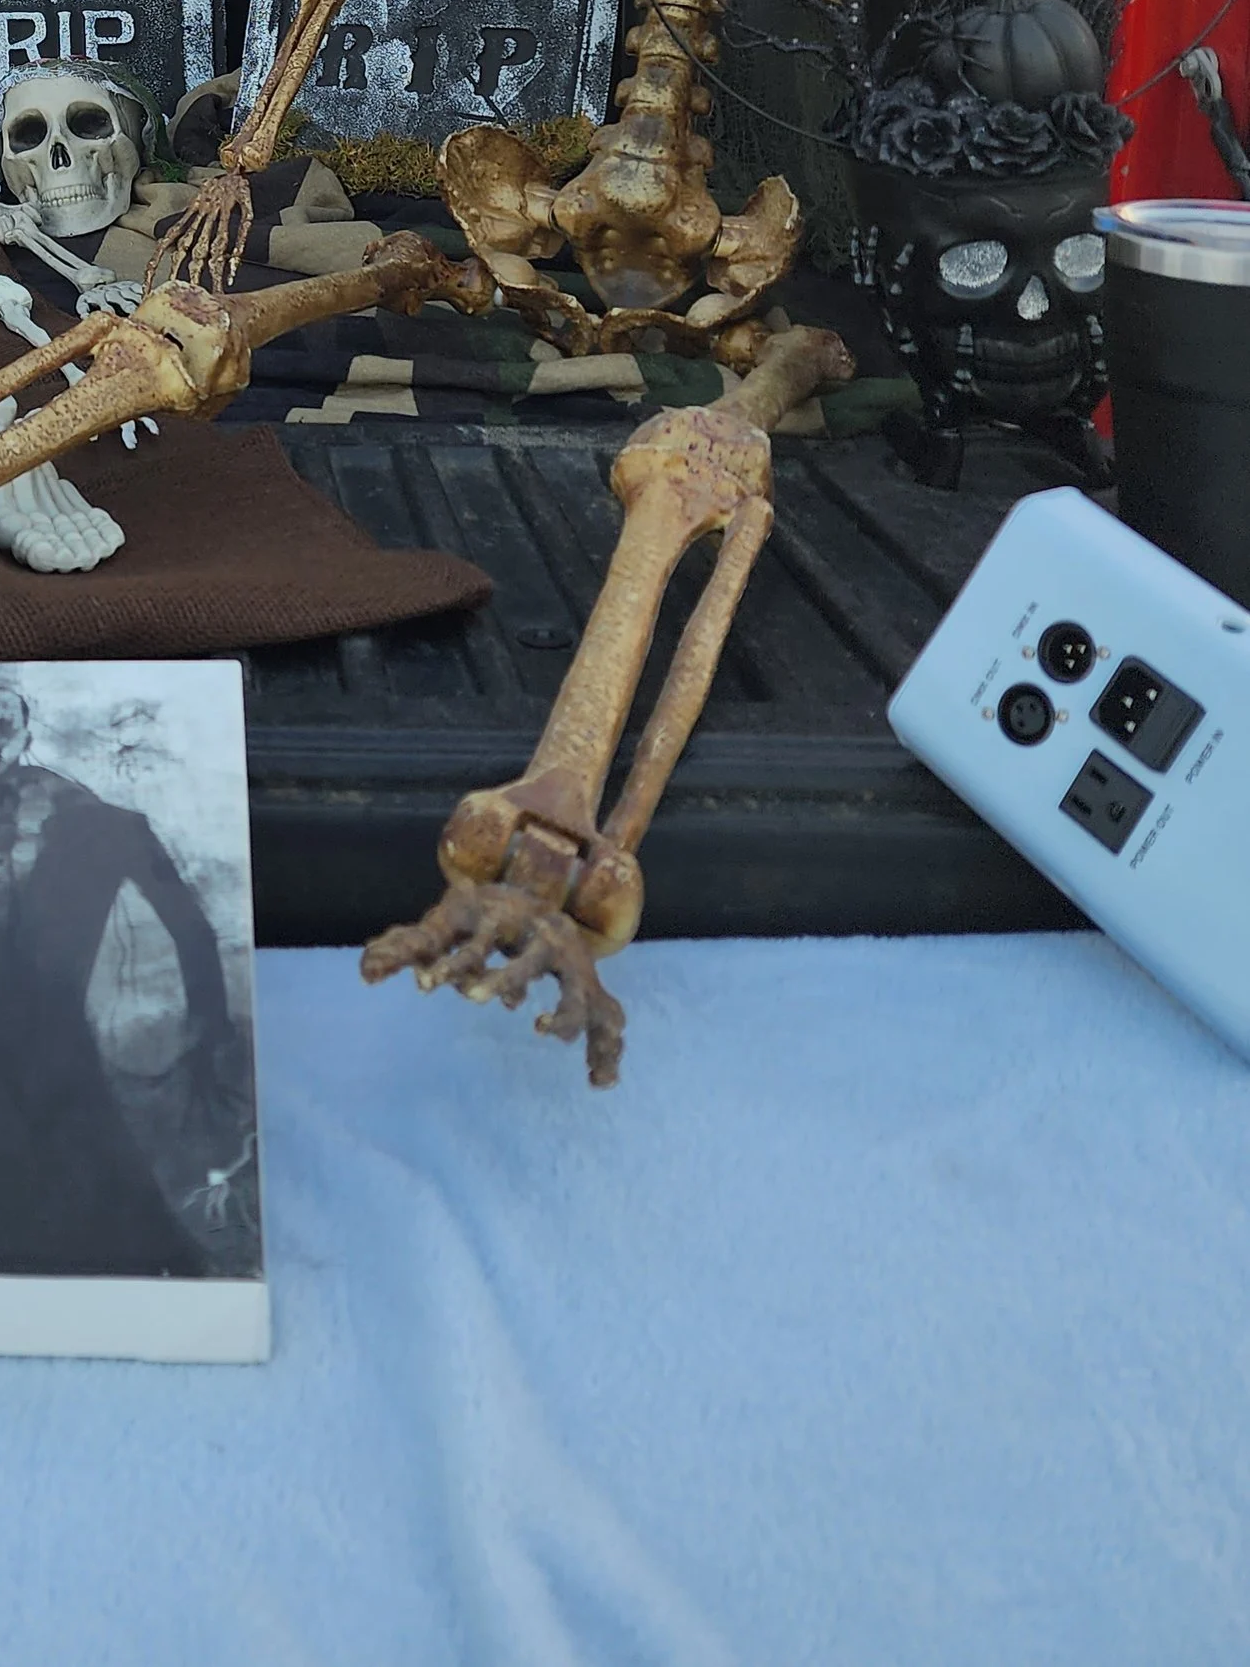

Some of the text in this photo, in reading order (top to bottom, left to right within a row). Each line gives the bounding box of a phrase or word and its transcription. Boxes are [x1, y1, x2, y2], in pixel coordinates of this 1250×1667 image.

[315, 22, 538, 98] RIP
[1184, 741, 1214, 785] POWER
[1129, 828, 1157, 870] POWER
